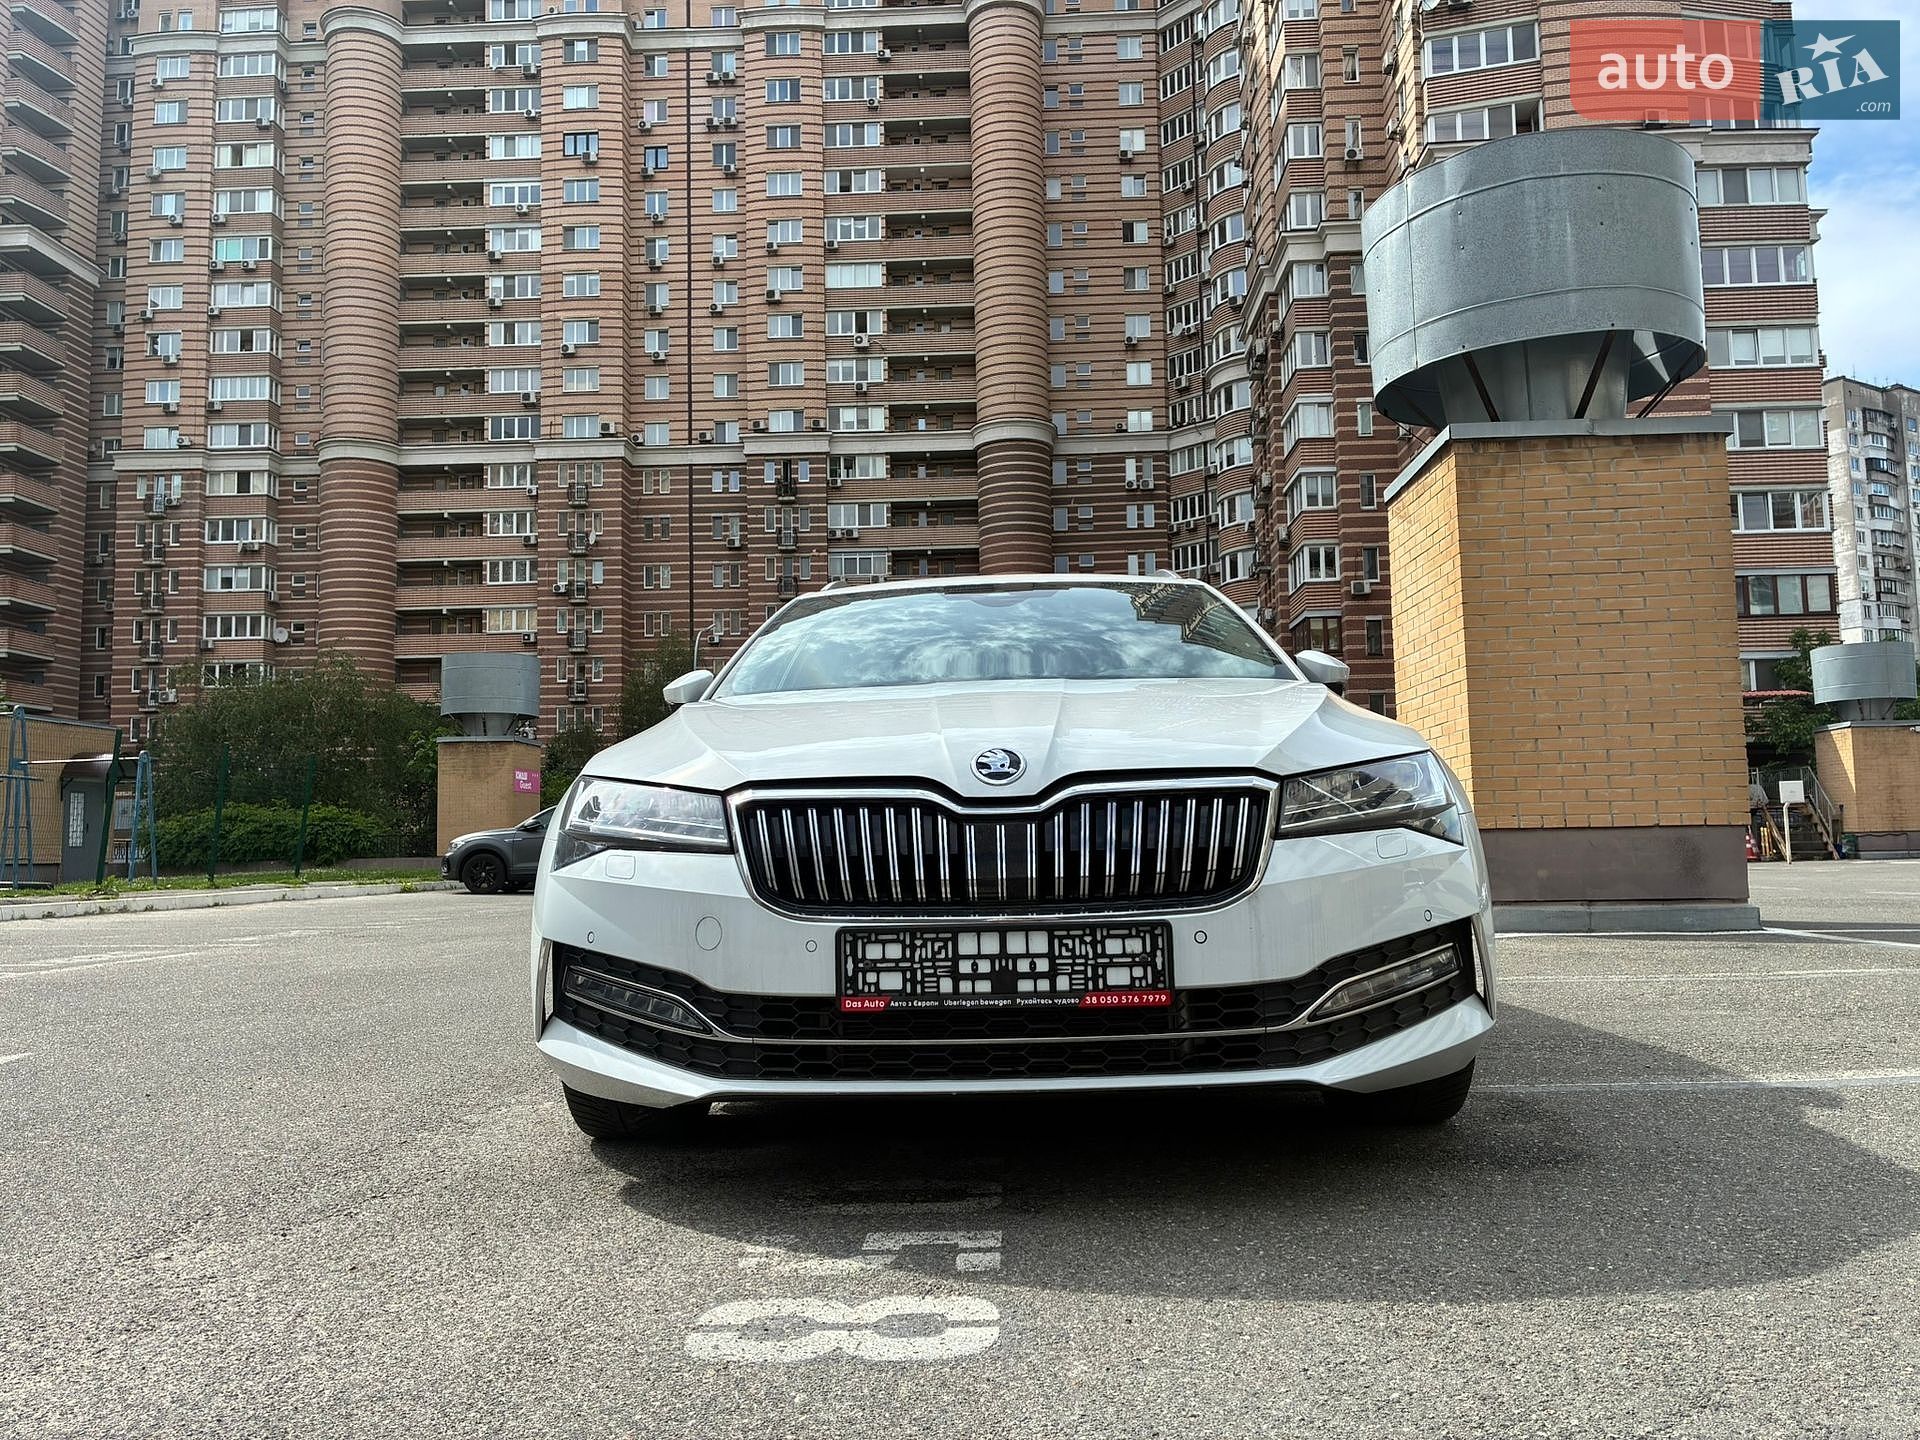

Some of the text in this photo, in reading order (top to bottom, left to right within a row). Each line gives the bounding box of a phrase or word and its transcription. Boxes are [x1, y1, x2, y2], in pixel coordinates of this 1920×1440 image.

[845, 999, 886, 1008] Das Auto
[889, 999, 907, 1007] Авто
[1085, 994, 1167, 1004] 38 050 576 7979
